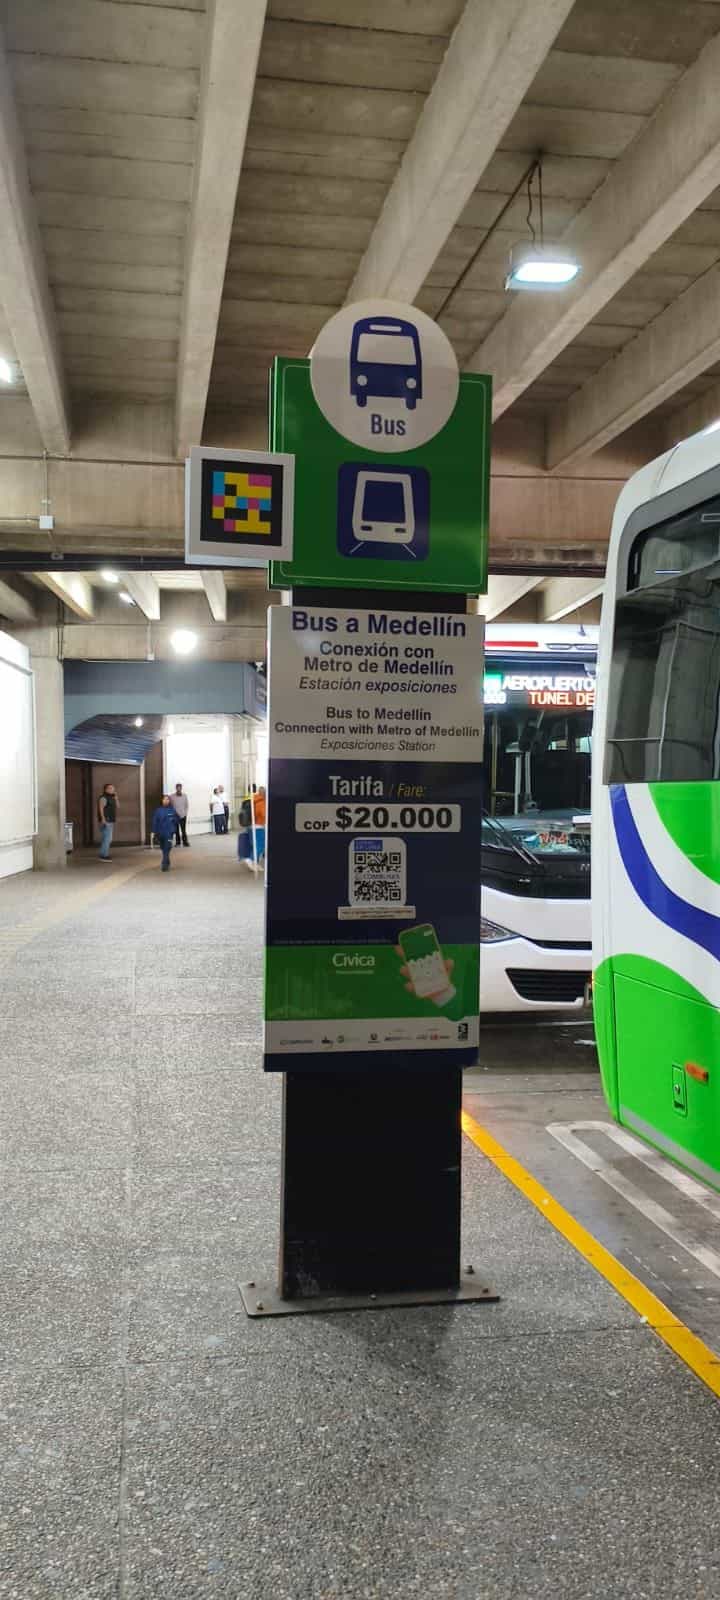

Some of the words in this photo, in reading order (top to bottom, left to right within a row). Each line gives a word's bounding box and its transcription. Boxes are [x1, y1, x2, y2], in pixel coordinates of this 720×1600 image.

[370, 413, 406, 436] Bus
[292, 611, 338, 632] Bus
[346, 617, 359, 633] a
[368, 614, 466, 637] Medellín
[320, 640, 398, 658] Conexión
[404, 646, 434, 659] con
[304, 656, 352, 673] Metro
[358, 659, 378, 673] de
[384, 659, 454, 676] Medellín
[299, 676, 361, 691] Estación
[365, 680, 457, 695] exposiciones
[502, 675, 595, 691] AEROPUERTO
[528, 691, 573, 705] TUNEL
[576, 691, 595, 706] DE
[326, 706, 353, 719] Bus
[357, 707, 370, 719] to
[274, 722, 345, 735] Connection
[349, 724, 373, 735] with
[377, 724, 411, 737] Metro
[415, 725, 427, 737] of
[320, 738, 395, 752] Exposiciones
[399, 740, 436, 752] Station
[328, 775, 384, 796] Tarifa
[303, 820, 330, 831] COP
[335, 806, 453, 831] $20.000
